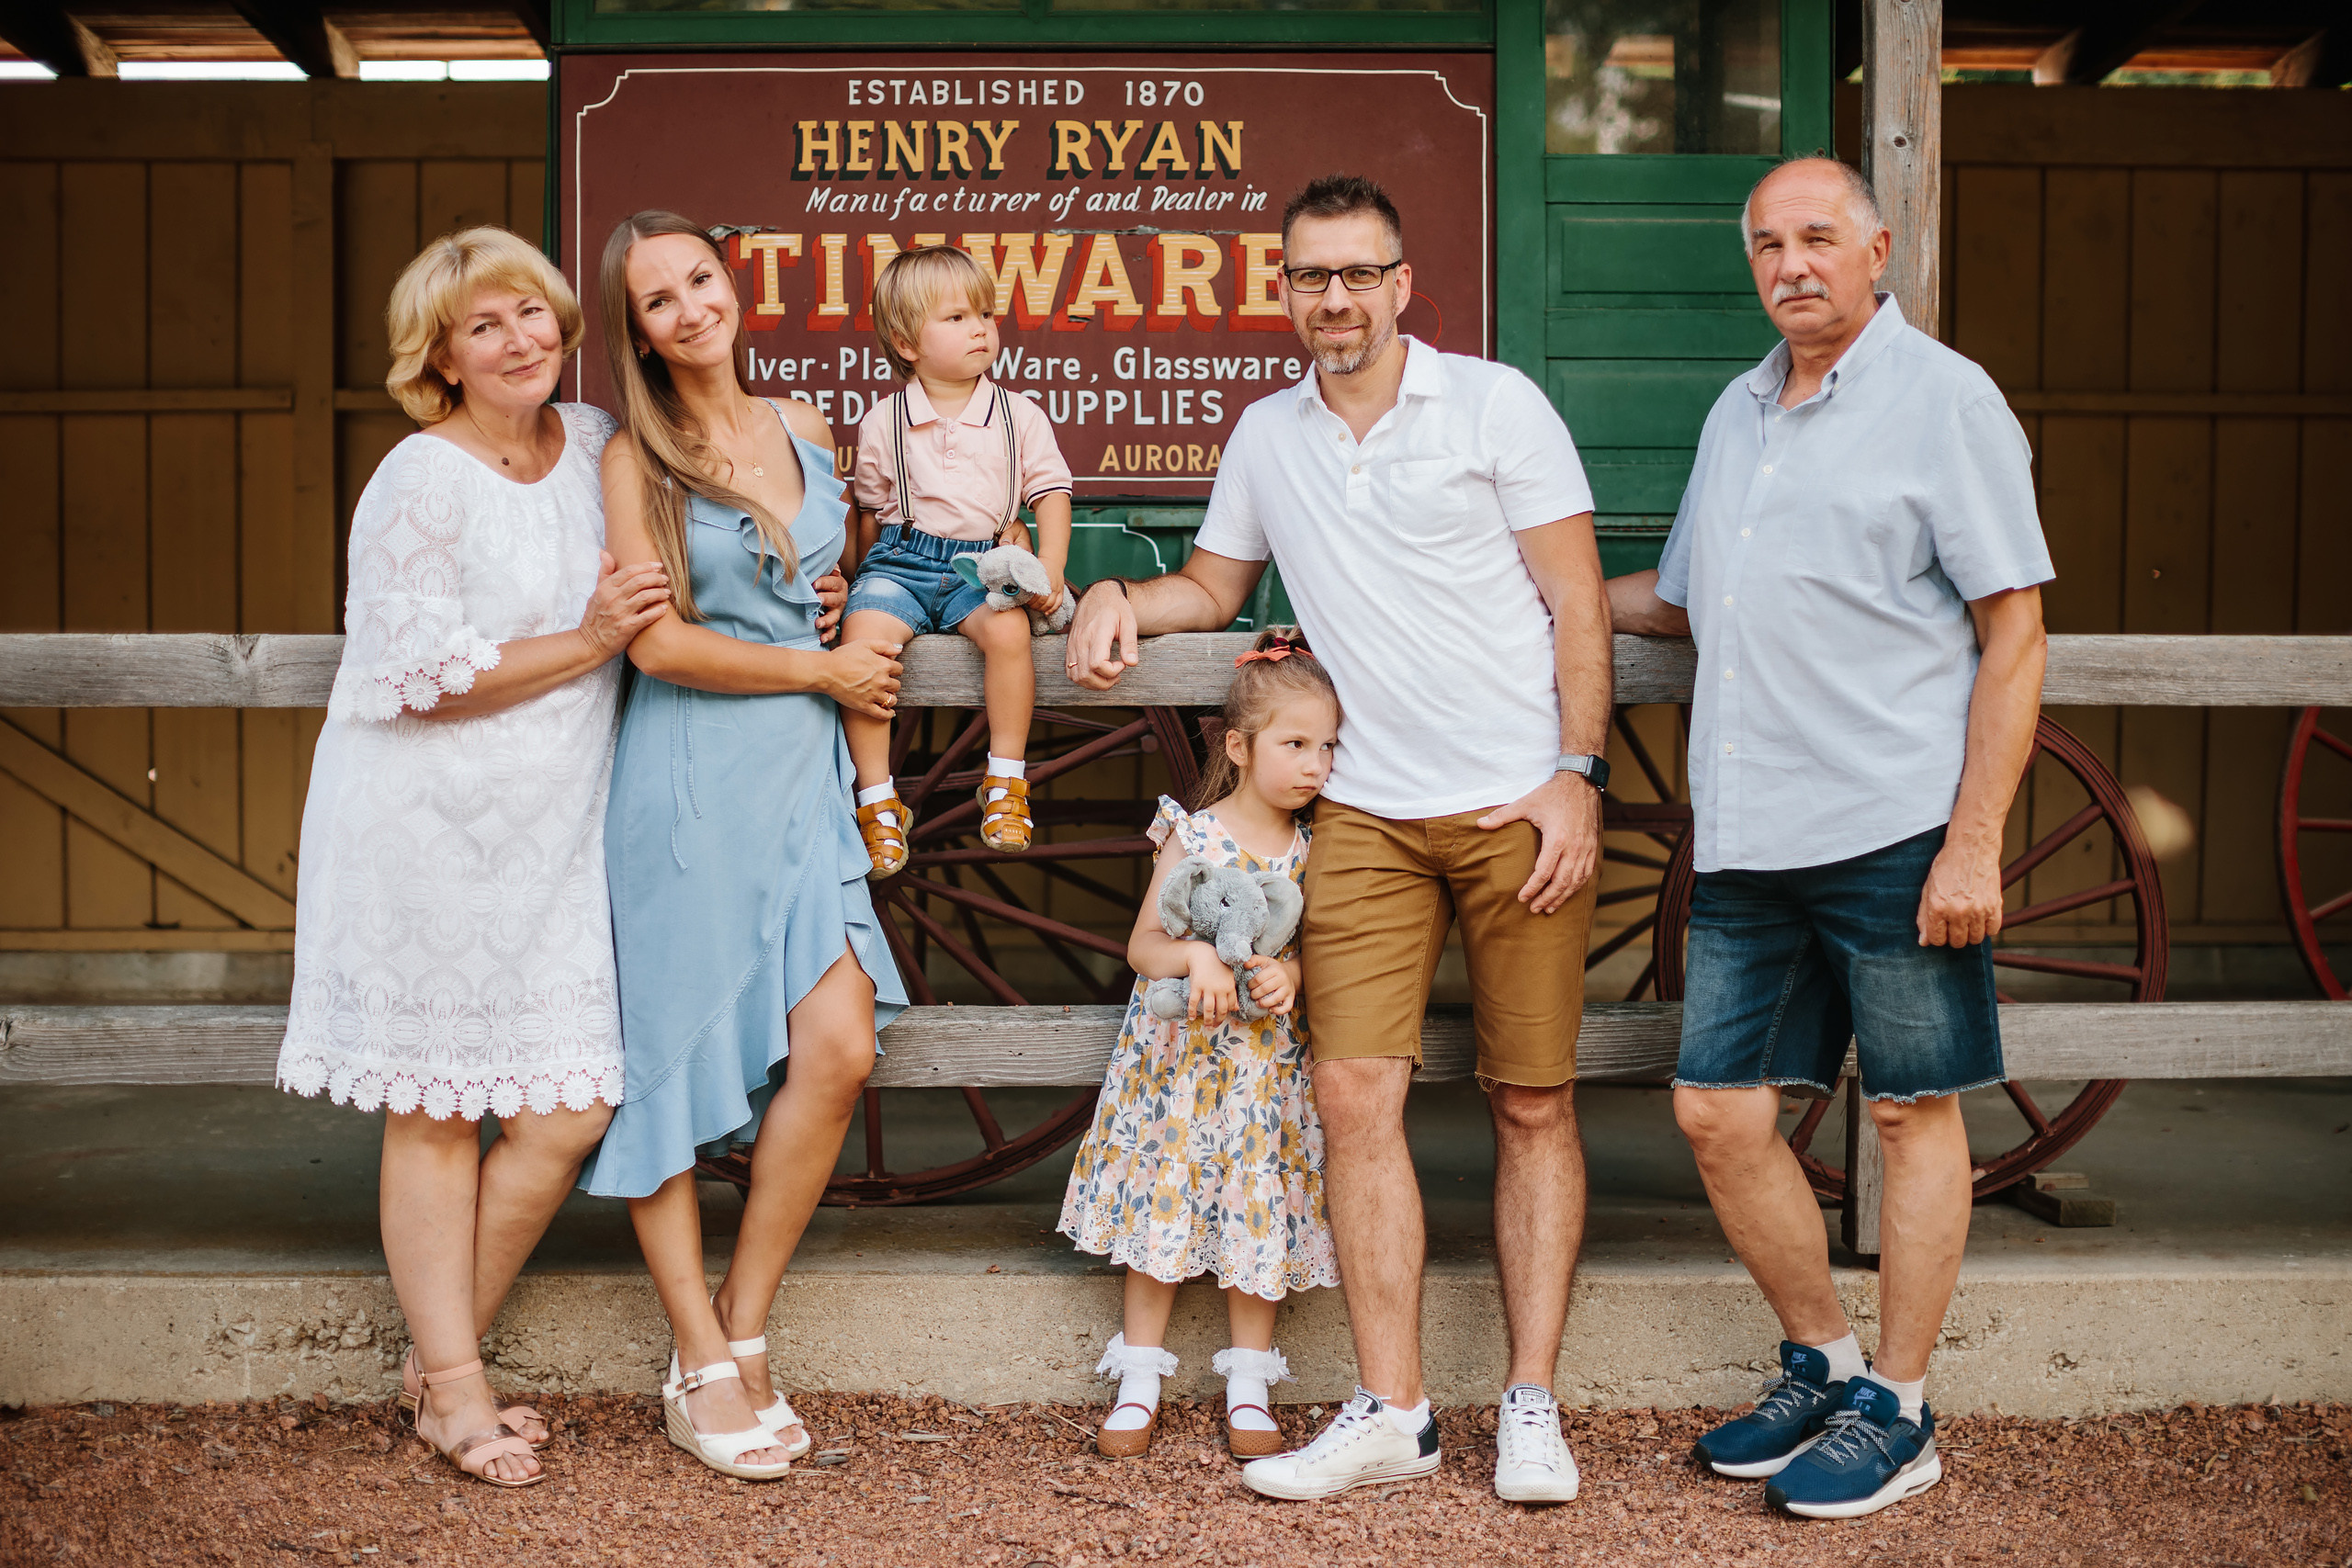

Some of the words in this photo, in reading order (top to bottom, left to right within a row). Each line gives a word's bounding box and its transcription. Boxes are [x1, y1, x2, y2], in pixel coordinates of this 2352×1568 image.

[849, 80, 1085, 105] ESTABLISHED
[1124, 80, 1204, 107] 1870
[793, 120, 1019, 180] HENRY
[1047, 120, 1244, 180] RYAN
[805, 186, 1041, 220] Manufacturer
[1048, 185, 1080, 222] of
[1086, 185, 1142, 212] and
[1150, 186, 1234, 212] Dealer
[1242, 184, 1268, 212] in
[1114, 346, 1302, 380] Glassware
[1099, 445, 1223, 472] AURORA
[1859, 1386, 1878, 1398] NIKE
[1853, 1400, 1871, 1412] AIR
